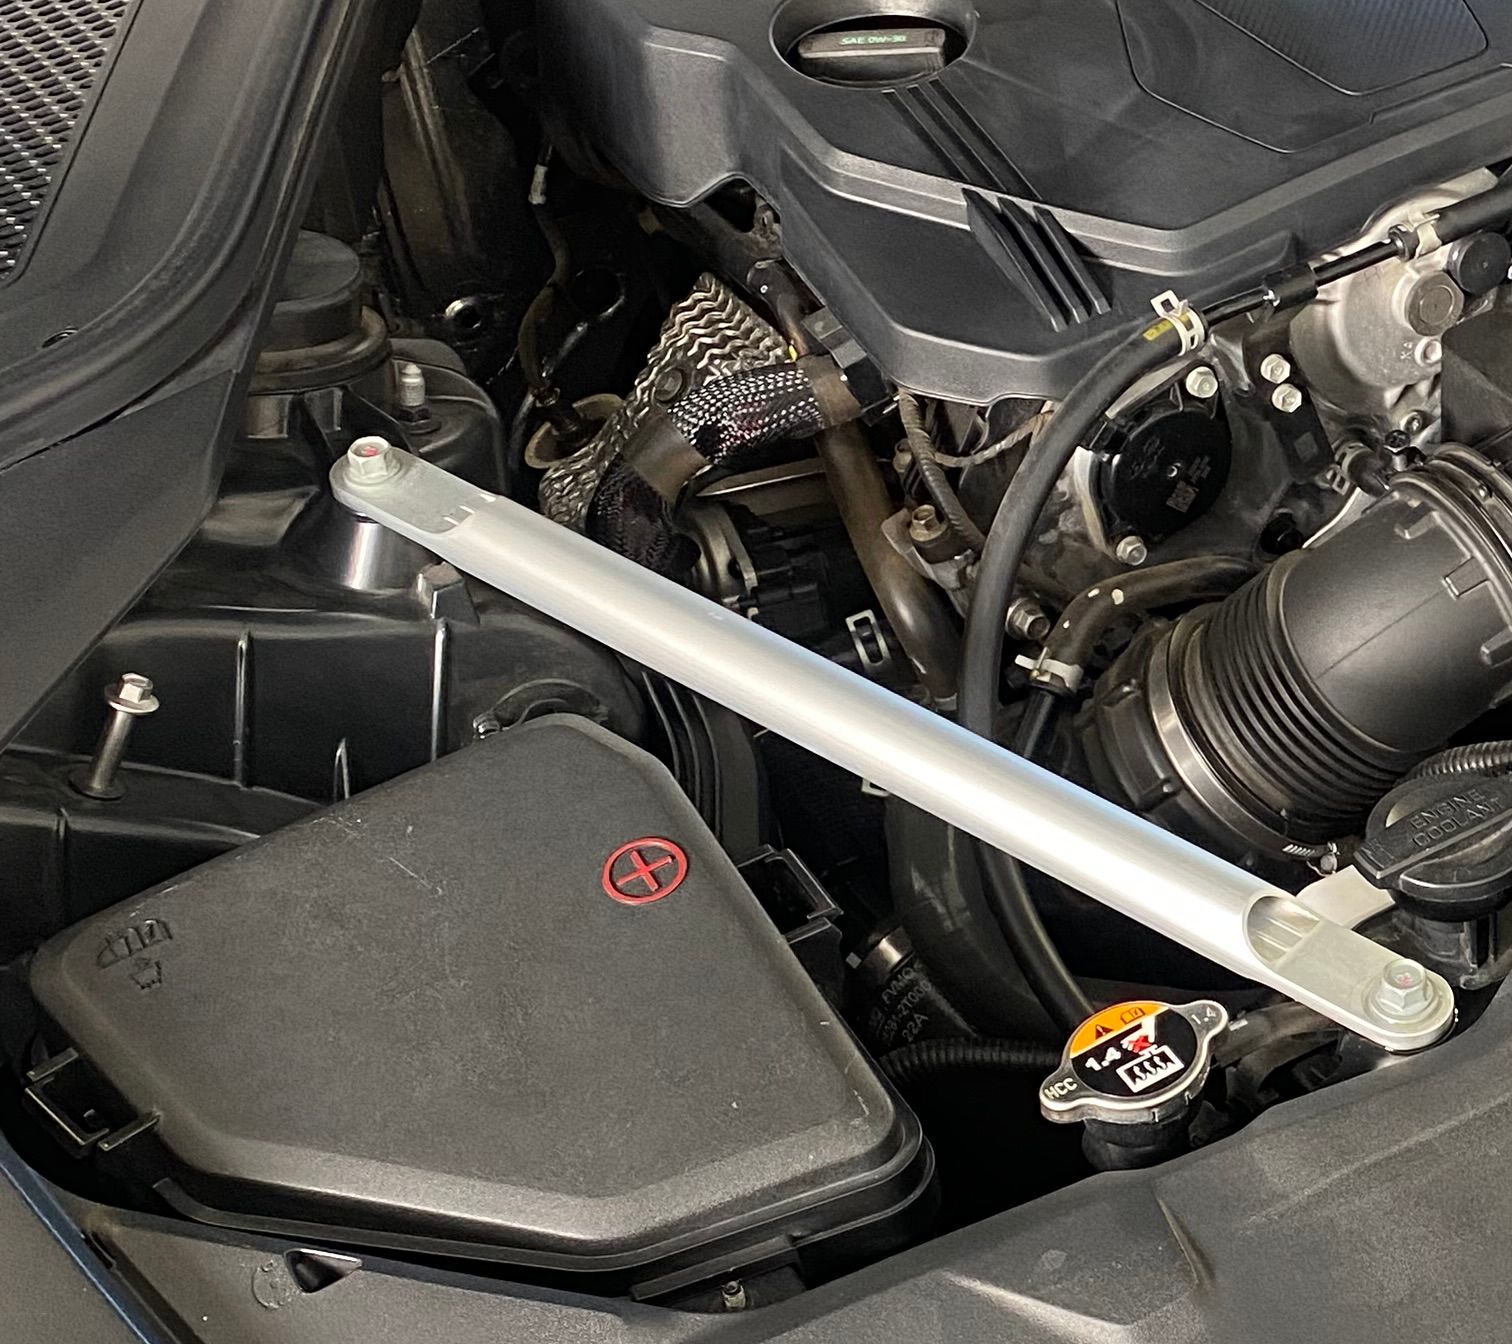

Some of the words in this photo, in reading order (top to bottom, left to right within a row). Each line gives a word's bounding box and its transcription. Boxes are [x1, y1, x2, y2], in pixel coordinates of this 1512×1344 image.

[840, 36, 865, 45] SAE
[1410, 788, 1485, 828] ENGINE
[1412, 797, 1505, 846] COOLANT
[1191, 1006, 1217, 1025] 1.4
[1085, 1046, 1122, 1072] 1.4
[1044, 1077, 1078, 1099] HCC
